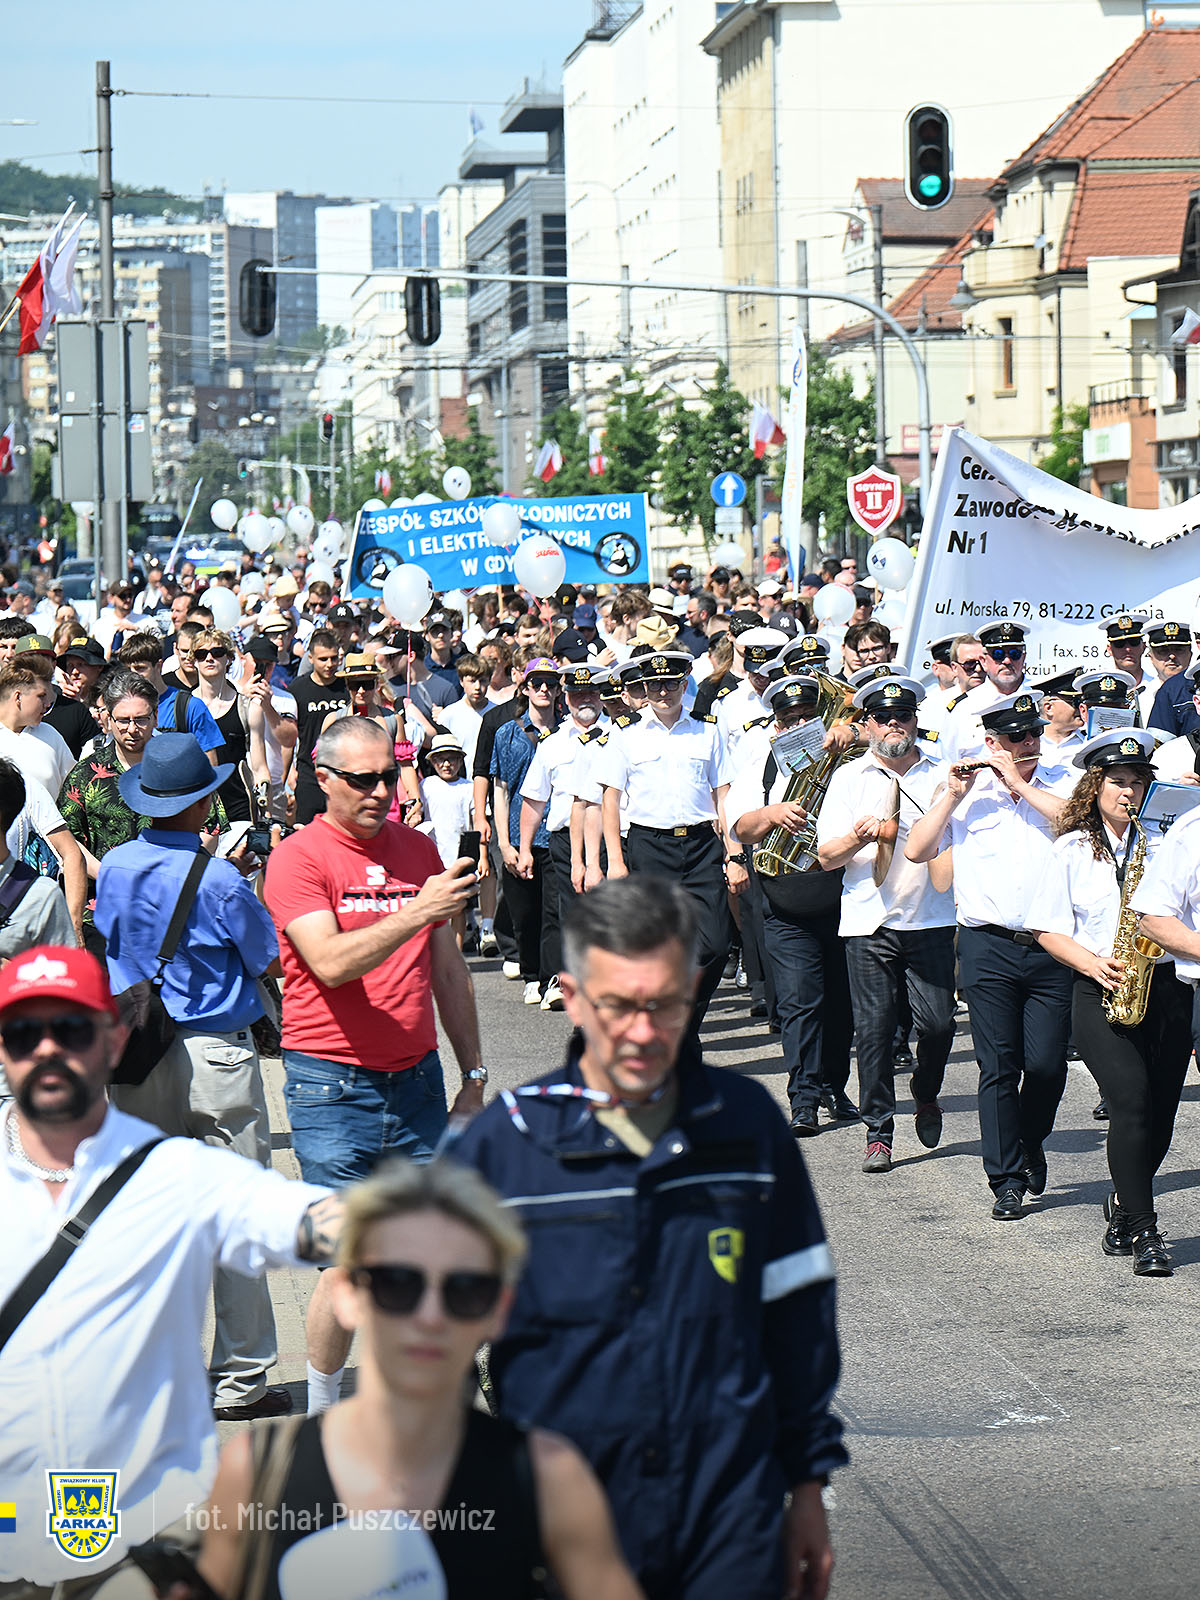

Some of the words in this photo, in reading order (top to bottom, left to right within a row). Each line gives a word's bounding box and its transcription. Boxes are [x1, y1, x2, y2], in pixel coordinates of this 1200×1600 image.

[855, 482, 893, 492] GDYNIA
[865, 492, 883, 510] II
[359, 509, 425, 535] ZESPÓŁ
[408, 539, 415, 557] I
[947, 530, 975, 554] Nr
[980, 531, 988, 554] 1
[461, 557, 478, 576] W
[484, 555, 515, 574] GDY
[935, 599, 954, 615] ul.
[960, 600, 1008, 618] Morska
[1013, 602, 1033, 620] 79,
[1038, 603, 1095, 620] 81-222
[1053, 644, 1078, 658] fax.
[1082, 645, 1099, 658] 58
